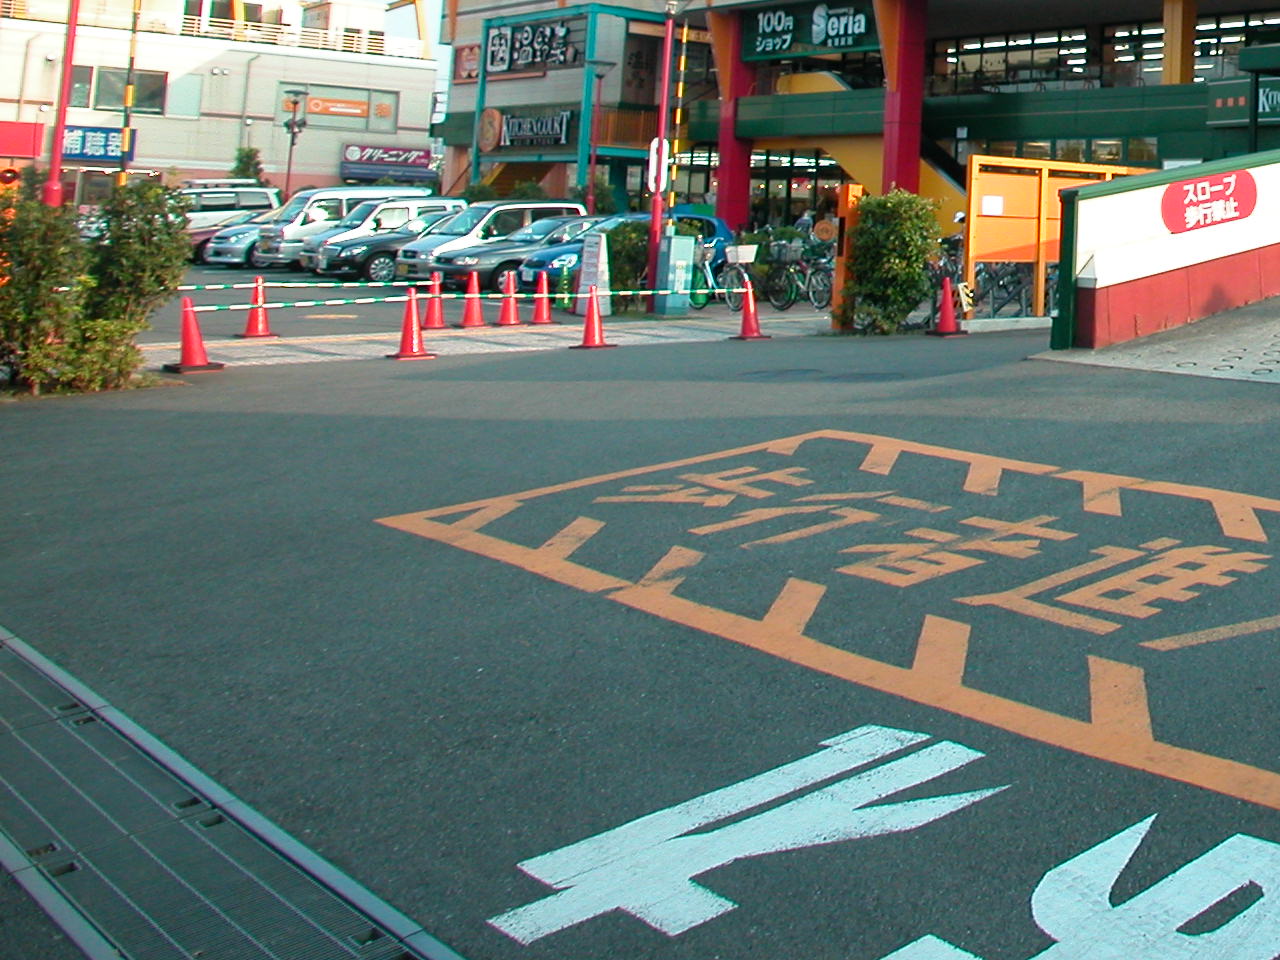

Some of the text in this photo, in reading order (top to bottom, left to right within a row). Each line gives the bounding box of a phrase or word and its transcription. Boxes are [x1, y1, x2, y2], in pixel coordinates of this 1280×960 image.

[812, 3, 866, 45] Seria
[361, 147, 425, 163] クリーニング
[1183, 173, 1237, 205] スロープ
